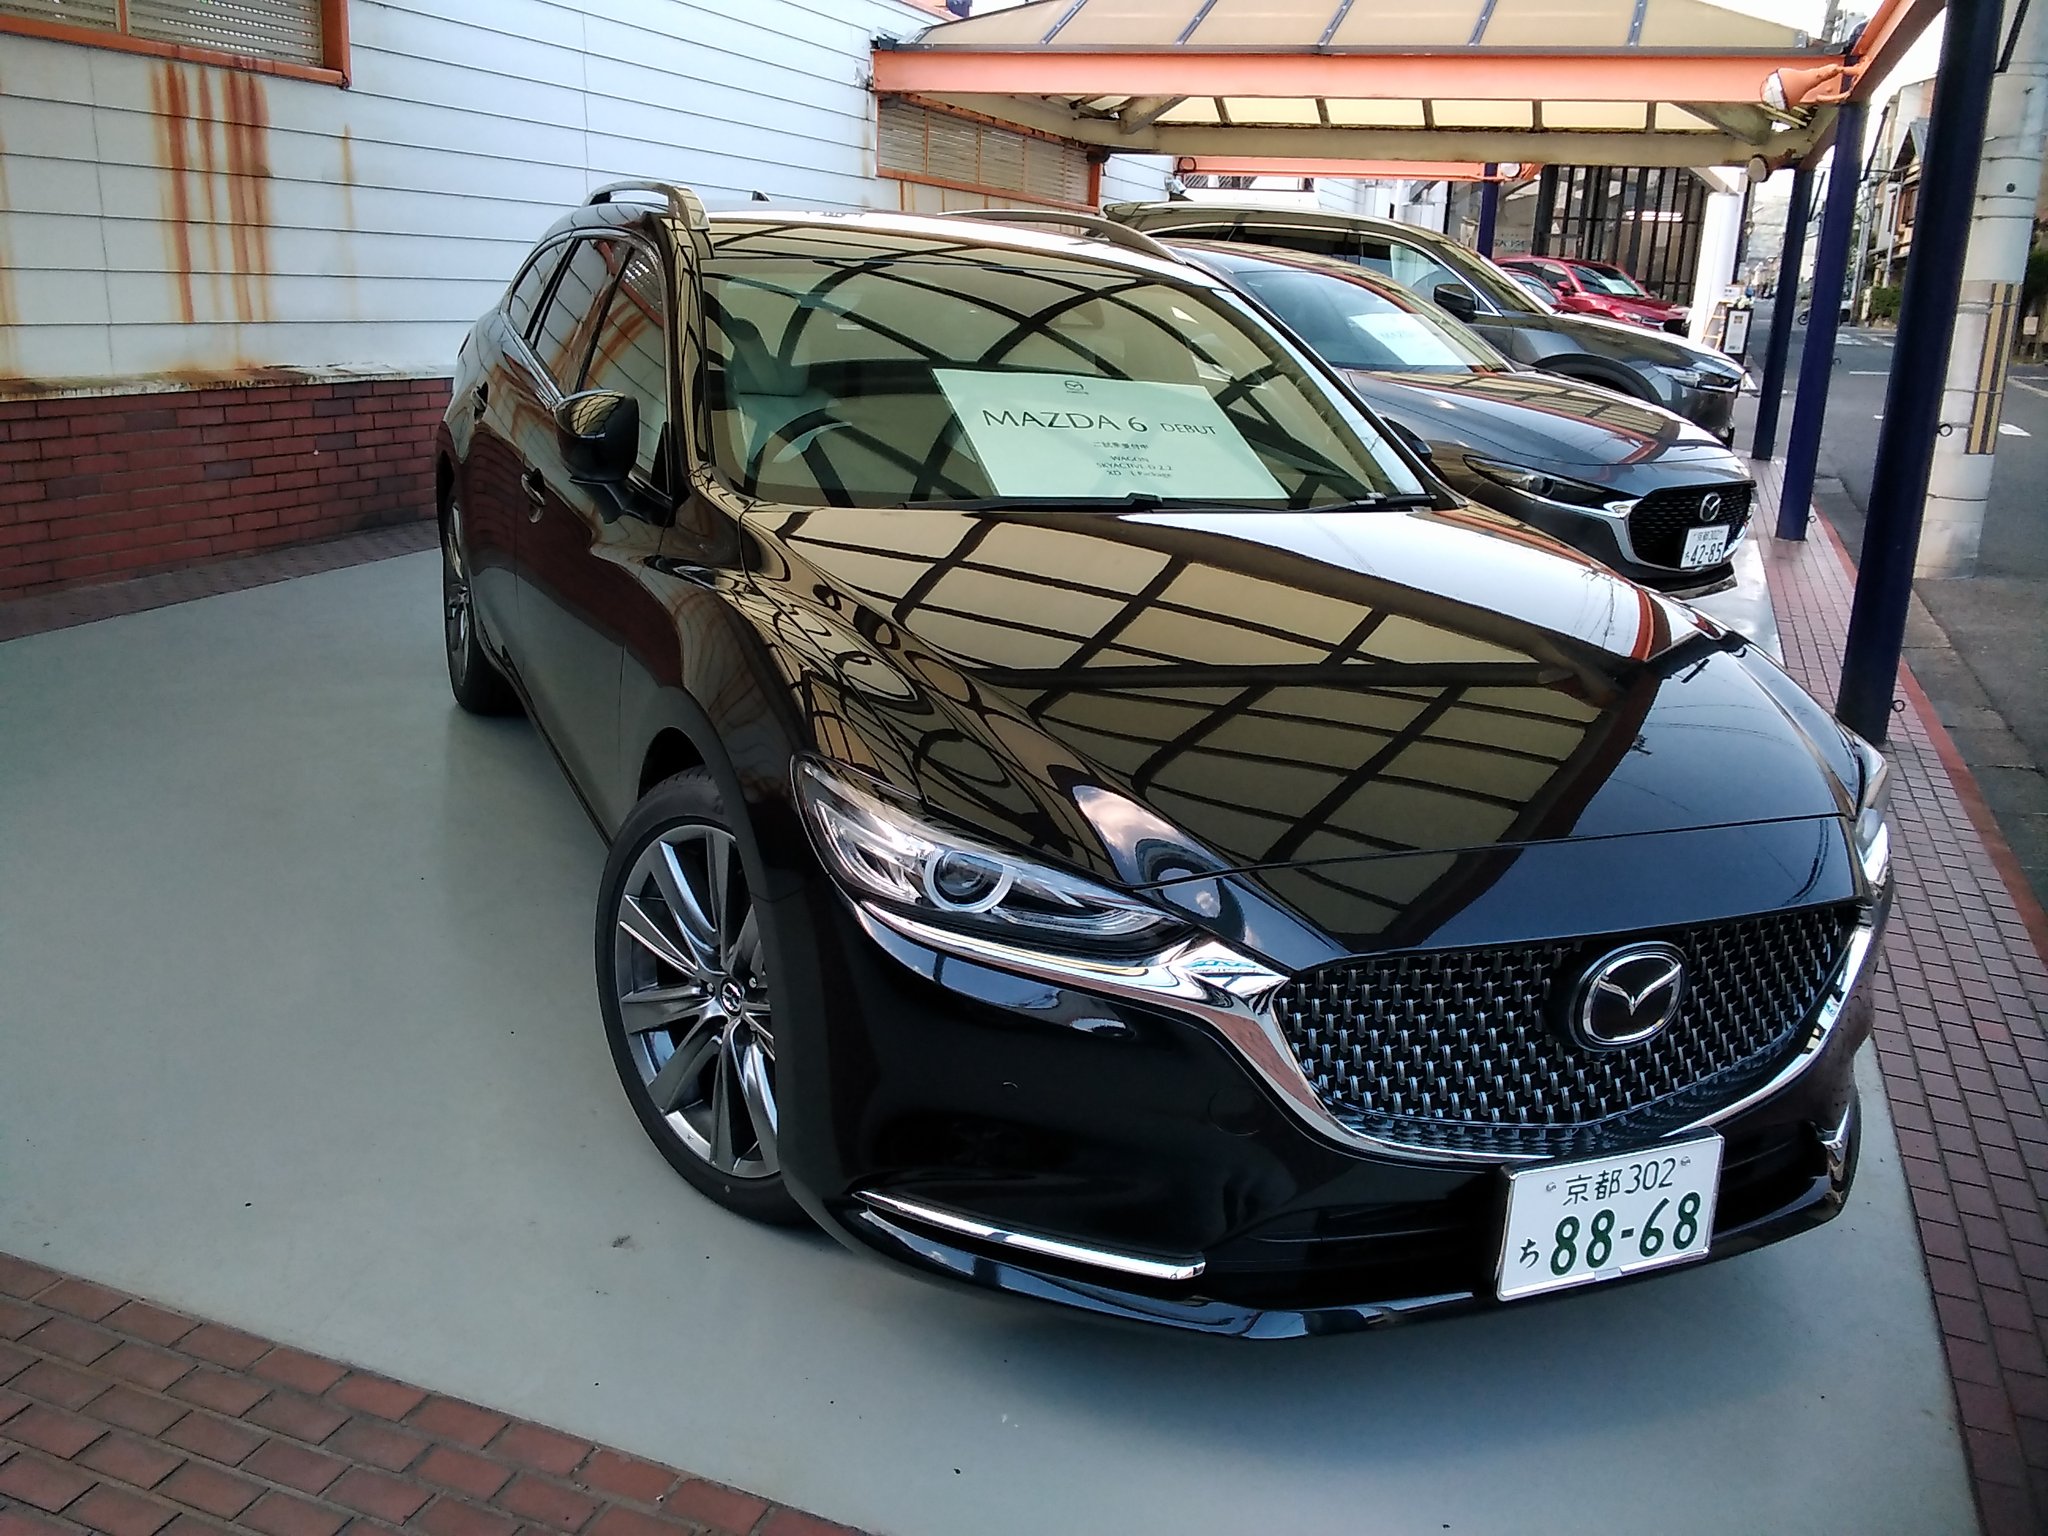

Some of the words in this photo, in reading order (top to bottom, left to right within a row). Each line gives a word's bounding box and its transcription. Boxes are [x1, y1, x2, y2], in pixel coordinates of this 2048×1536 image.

[982, 409, 1121, 431] MAZDA
[1127, 416, 1148, 433] 6
[1159, 422, 1217, 435] DEBUT
[1690, 541, 1724, 565] 42-85
[1562, 1157, 1676, 1206] 京都302
[1519, 1238, 1540, 1268] ち
[1549, 1191, 1701, 1276] 88-68
